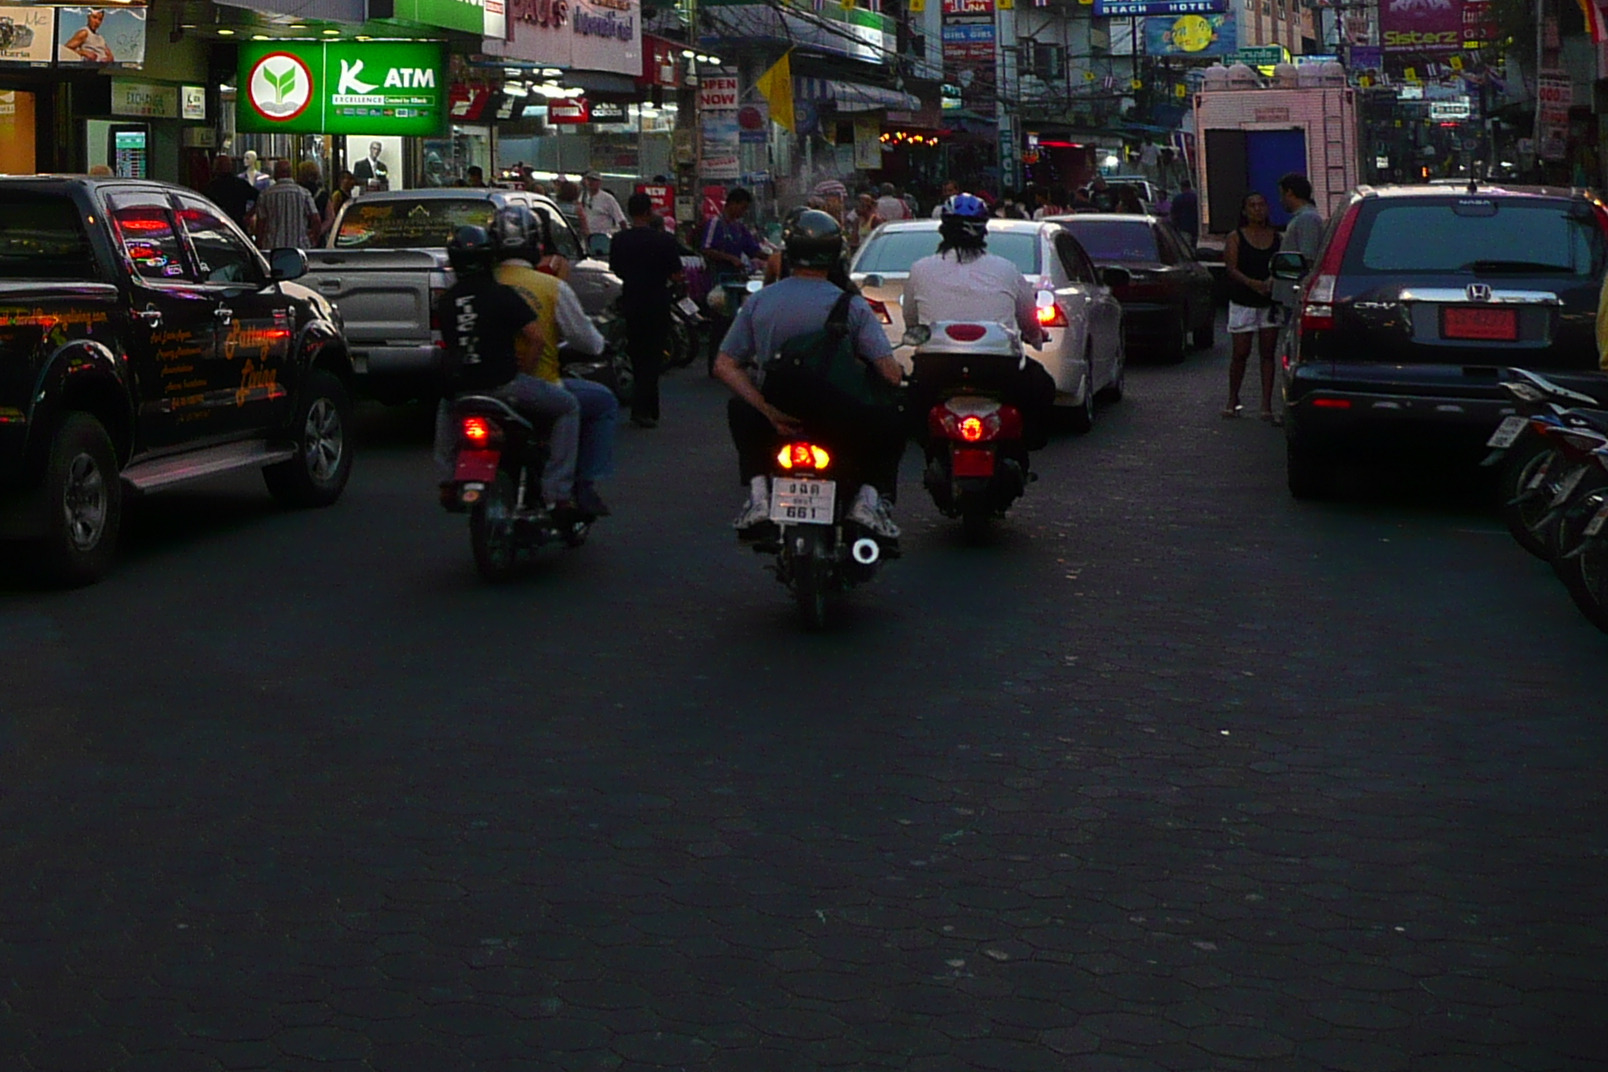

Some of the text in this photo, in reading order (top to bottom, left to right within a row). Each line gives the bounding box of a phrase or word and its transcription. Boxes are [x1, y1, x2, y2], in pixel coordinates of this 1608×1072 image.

[1103, 2, 1214, 14] BEACH HOTEL
[1382, 30, 1459, 47] Sisterz
[338, 59, 435, 95] K ATM
[335, 96, 382, 105] EXCELLENCE
[700, 92, 737, 106] NOW
[786, 506, 816, 519] 661
